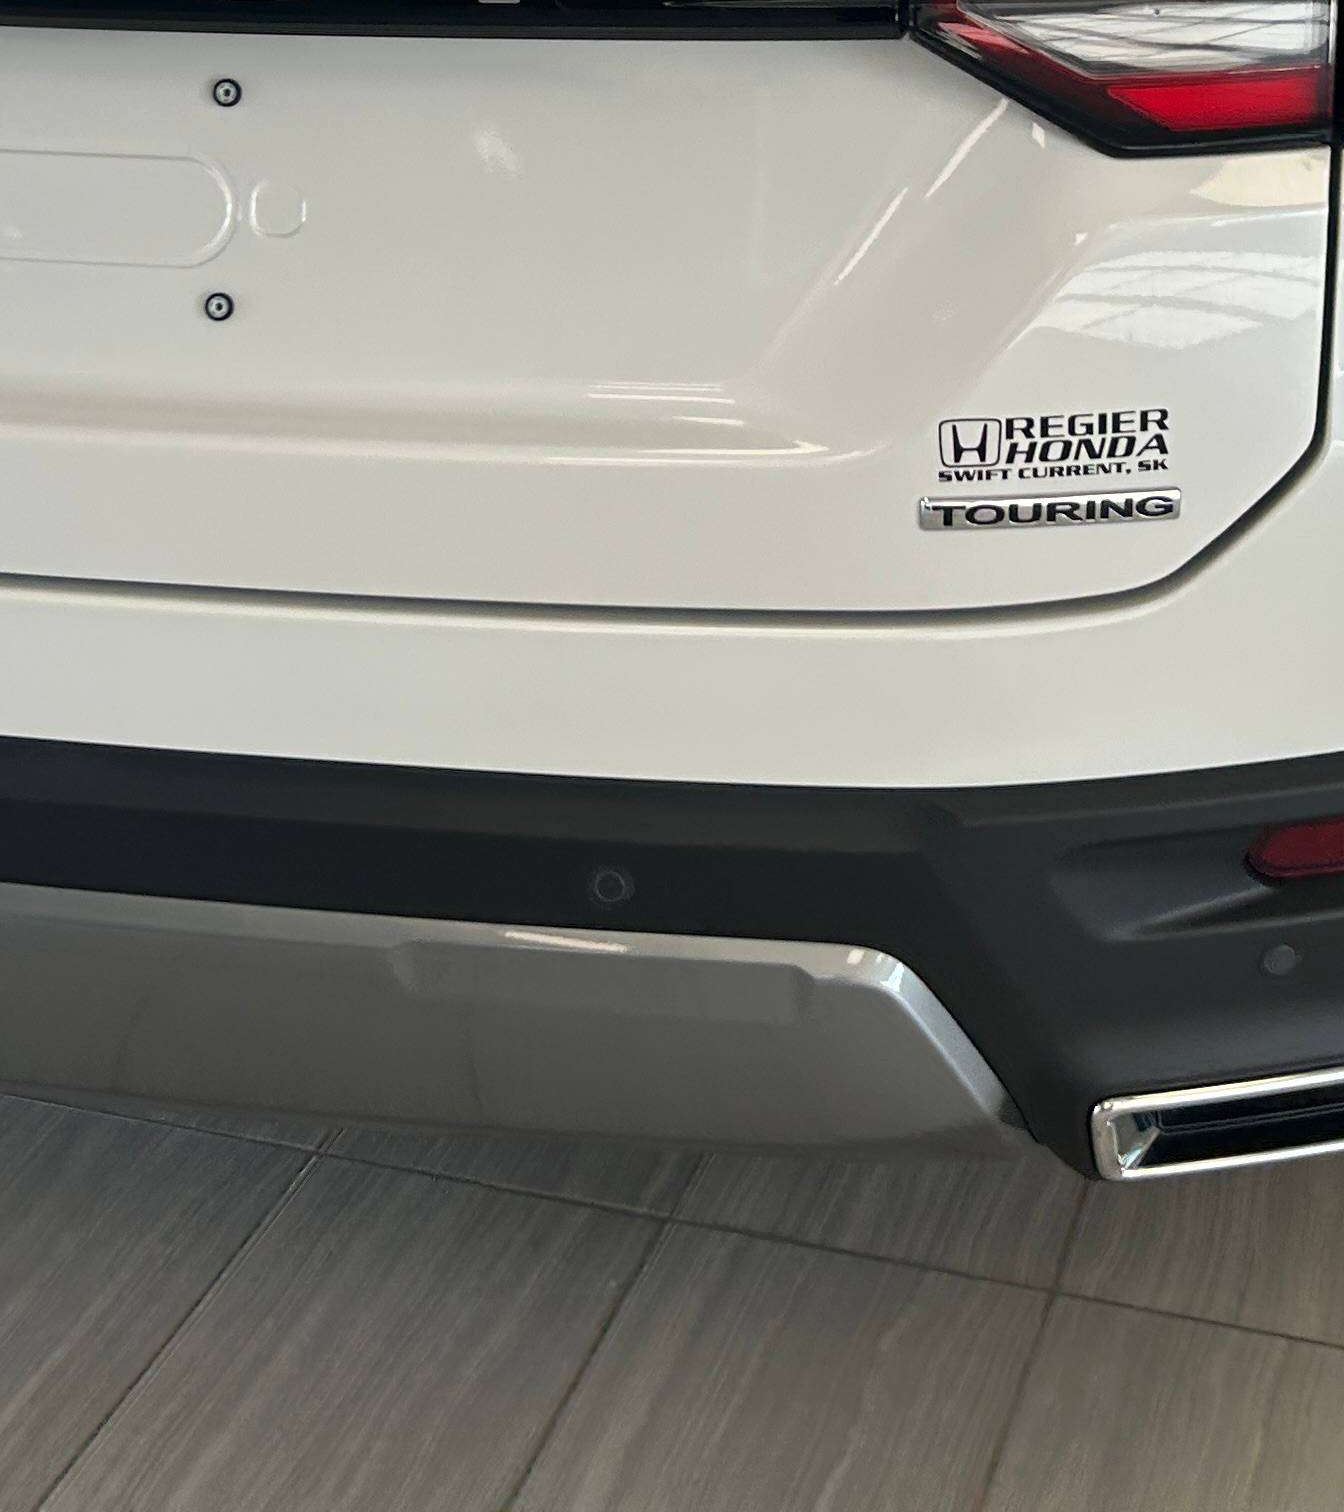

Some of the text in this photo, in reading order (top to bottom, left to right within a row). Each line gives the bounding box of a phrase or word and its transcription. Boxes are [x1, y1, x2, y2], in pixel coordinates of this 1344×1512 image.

[1005, 408, 1169, 440] REGIER
[1005, 433, 1169, 465] HONDA
[937, 458, 1169, 483] SWIFT CURRENT, SK
[932, 495, 1174, 527] TOURING
